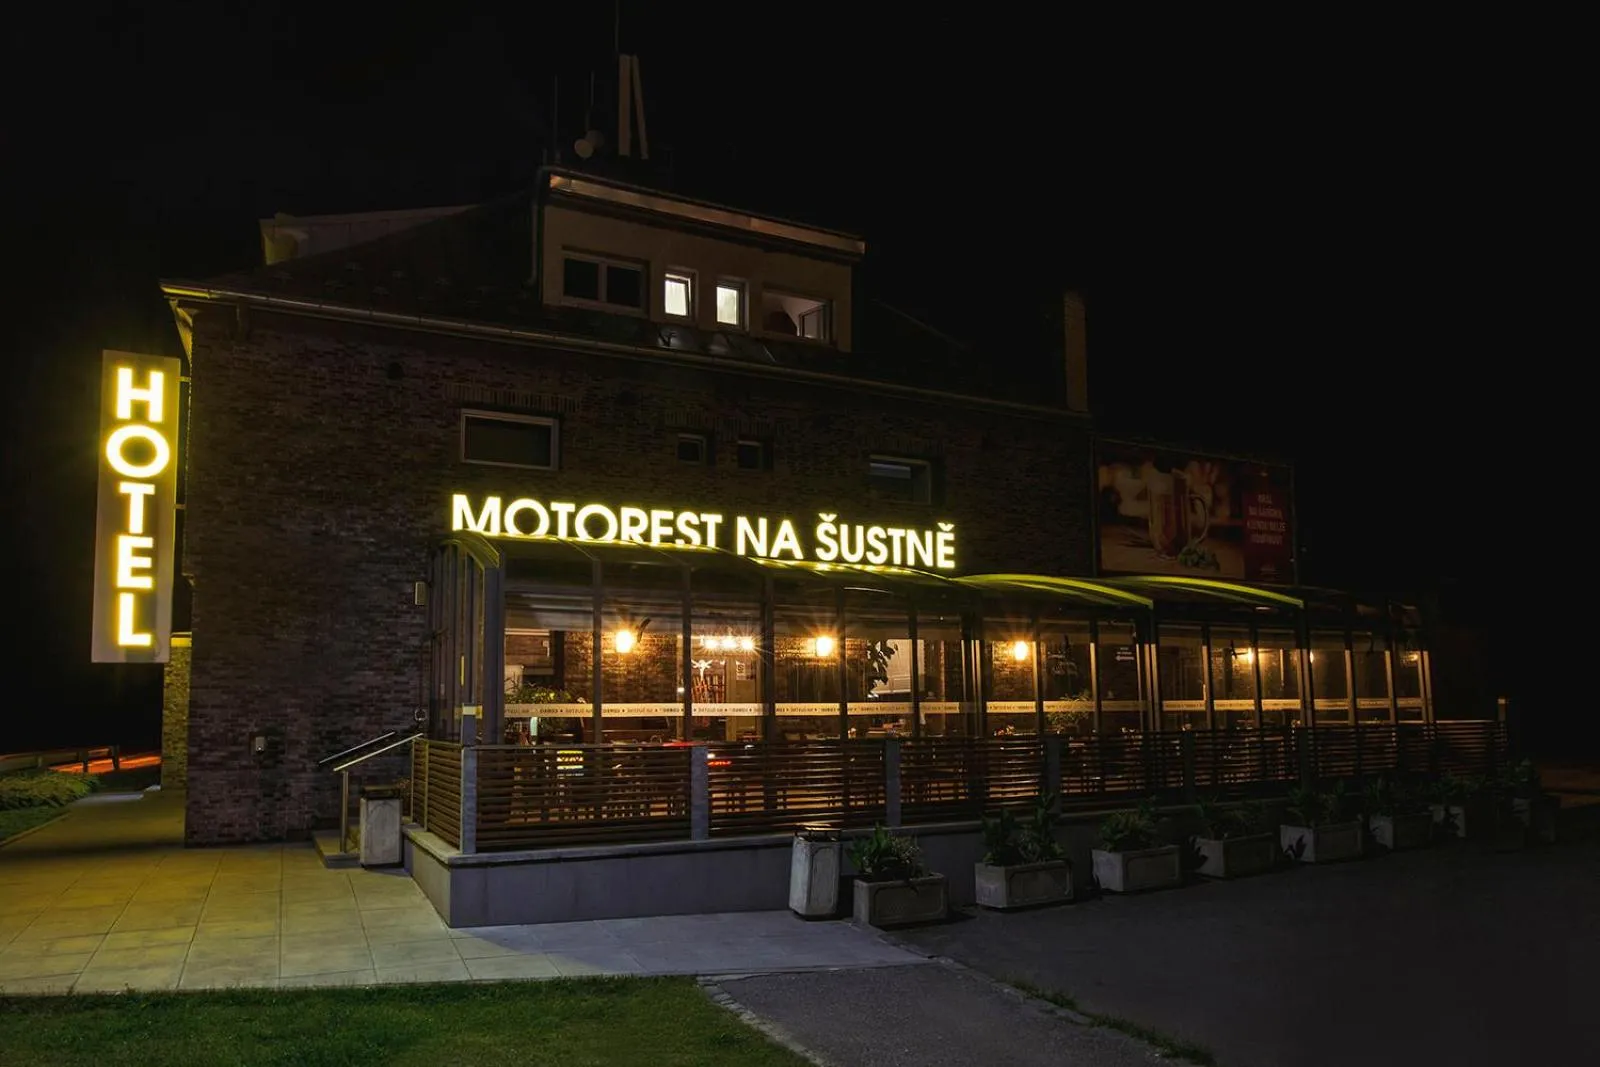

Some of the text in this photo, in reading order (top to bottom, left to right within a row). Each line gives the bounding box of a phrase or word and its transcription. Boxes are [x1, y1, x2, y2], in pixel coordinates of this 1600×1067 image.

[105, 366, 171, 647] HOTEL
[451, 493, 956, 569] MOTOREST NA ŠUSTNĚ
